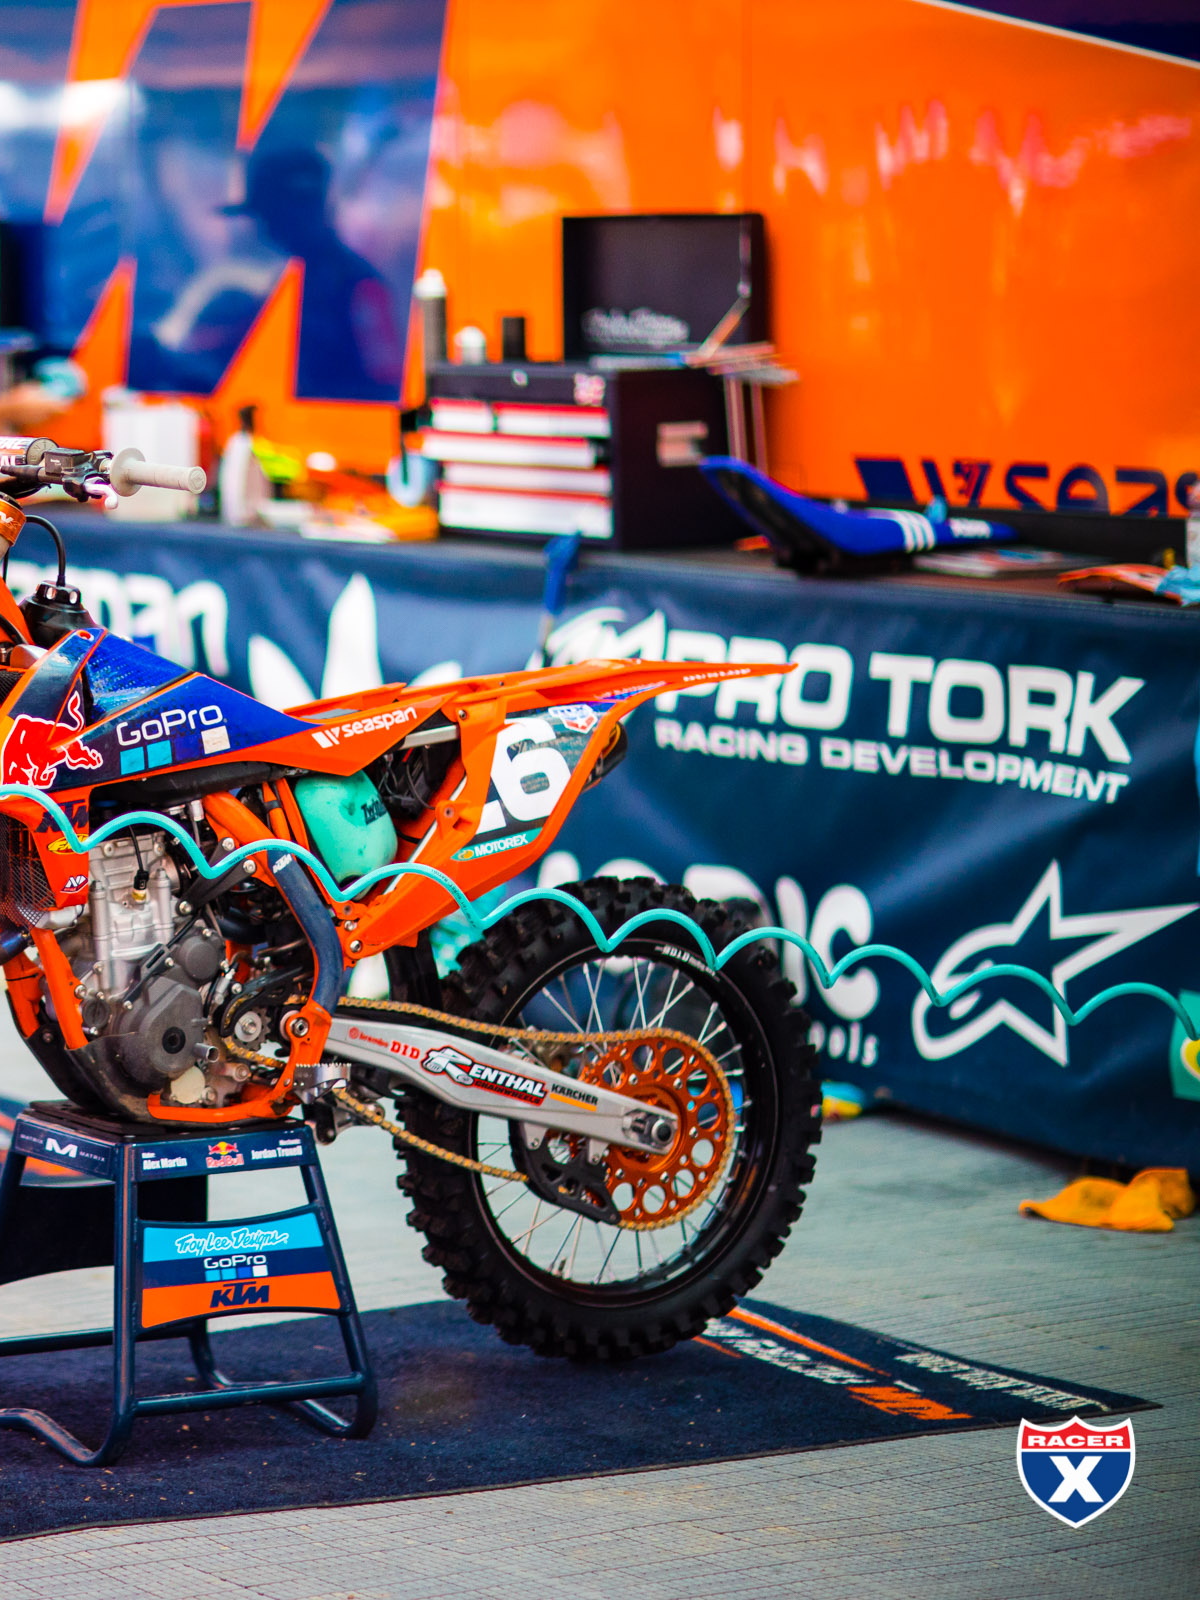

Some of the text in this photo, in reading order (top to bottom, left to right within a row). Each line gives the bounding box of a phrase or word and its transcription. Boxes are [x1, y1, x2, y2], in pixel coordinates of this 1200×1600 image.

[656, 629, 1146, 764] PRO TORK
[116, 704, 223, 746] GoPro
[342, 707, 418, 738] seaspan
[654, 717, 1131, 804] RACING DEVELOPMENT
[474, 833, 529, 857] MOTOREX
[390, 1041, 420, 1060] DID
[143, 1157, 187, 1170] Alex Martin
[206, 1154, 244, 1168] Red Bull
[175, 1227, 290, 1256] Troy Lee Designs
[204, 1254, 267, 1269] GoPro
[209, 1281, 270, 1308] KTM
